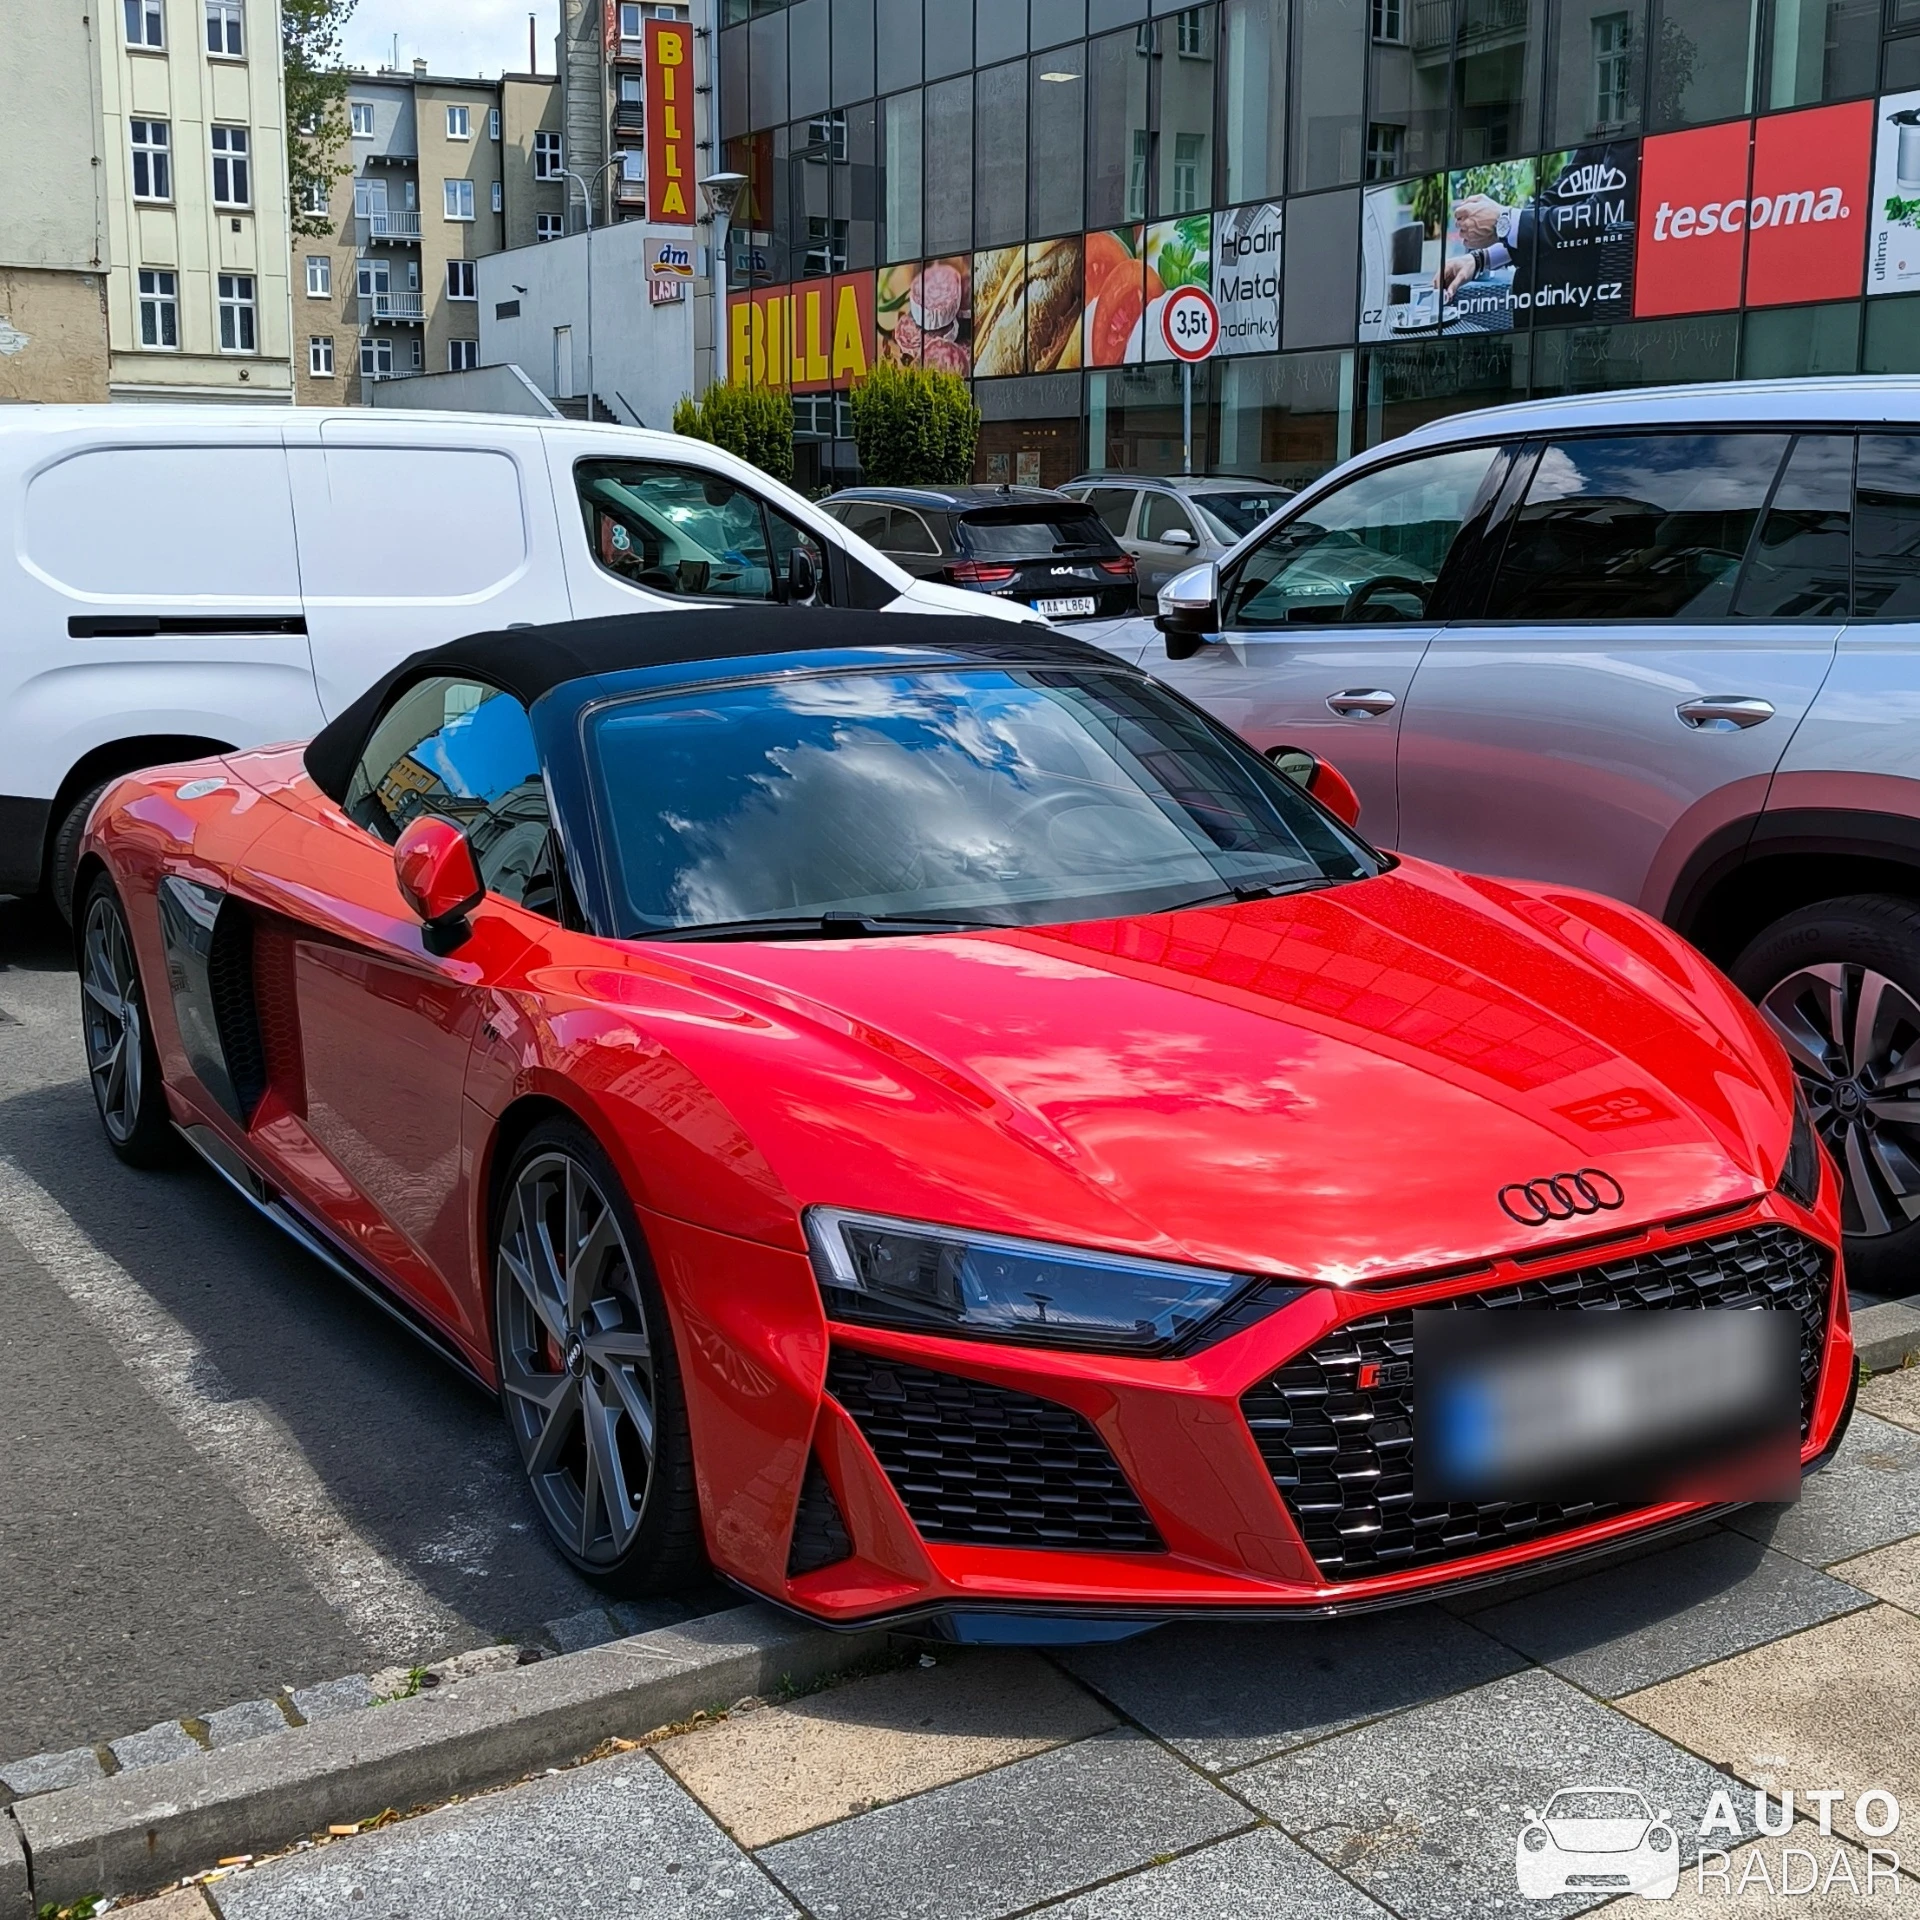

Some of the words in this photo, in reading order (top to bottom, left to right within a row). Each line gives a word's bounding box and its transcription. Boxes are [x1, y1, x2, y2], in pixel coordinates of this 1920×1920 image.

[657, 31, 687, 215] BILLA
[1567, 164, 1618, 194] PRIM
[1557, 199, 1625, 232] PRIM
[659, 244, 689, 264] dm
[1556, 238, 1589, 249] CZECH
[1874, 231, 1888, 281] ultima
[1220, 273, 1281, 303] Mato
[1456, 282, 1622, 320] prim-hodinky.cz
[731, 285, 868, 391] BILLA
[1176, 310, 1208, 339] 3,5t
[1040, 601, 1059, 613] 1AA
[1064, 599, 1091, 612] L864
